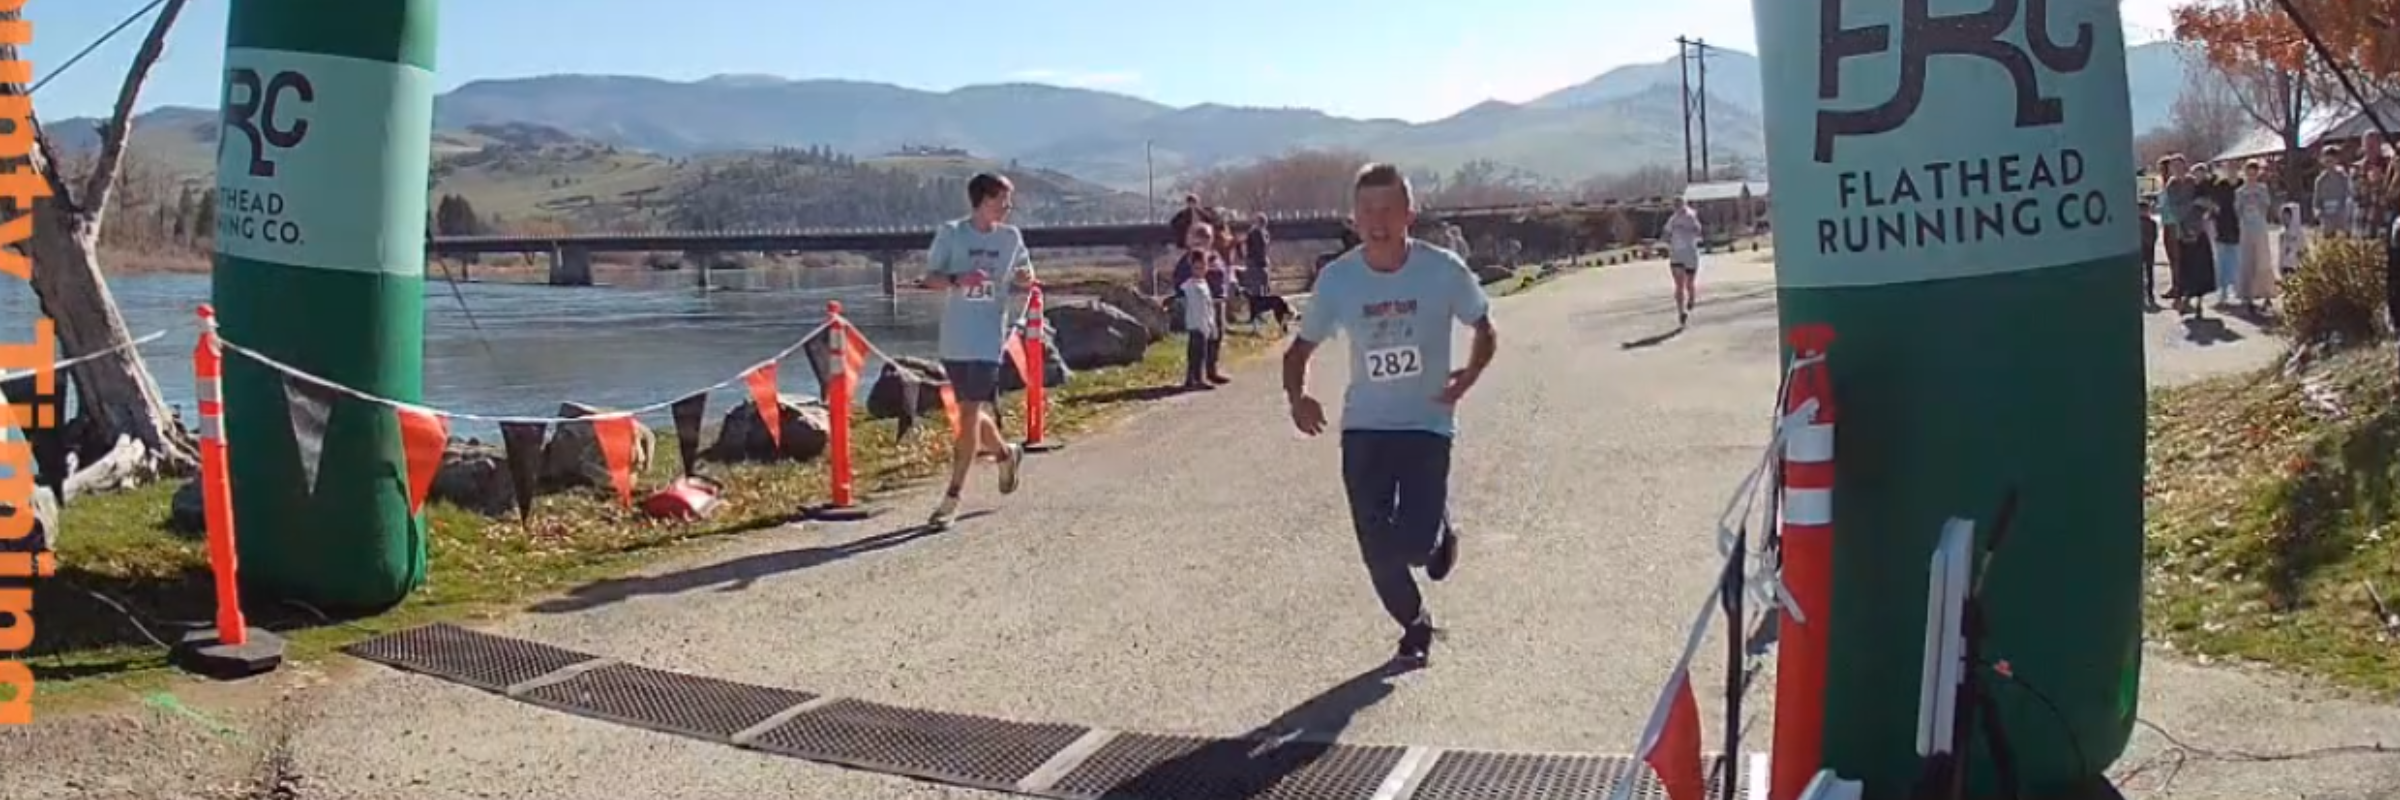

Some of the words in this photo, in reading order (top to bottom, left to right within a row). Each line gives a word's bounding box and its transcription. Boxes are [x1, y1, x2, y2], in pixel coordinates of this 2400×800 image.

[1838, 148, 2084, 208] FLATHEAD
[262, 218, 304, 245] CO.
[1817, 199, 2040, 254] RUNNING
[2057, 191, 2112, 230] CO.
[1369, 350, 1418, 376] 282
